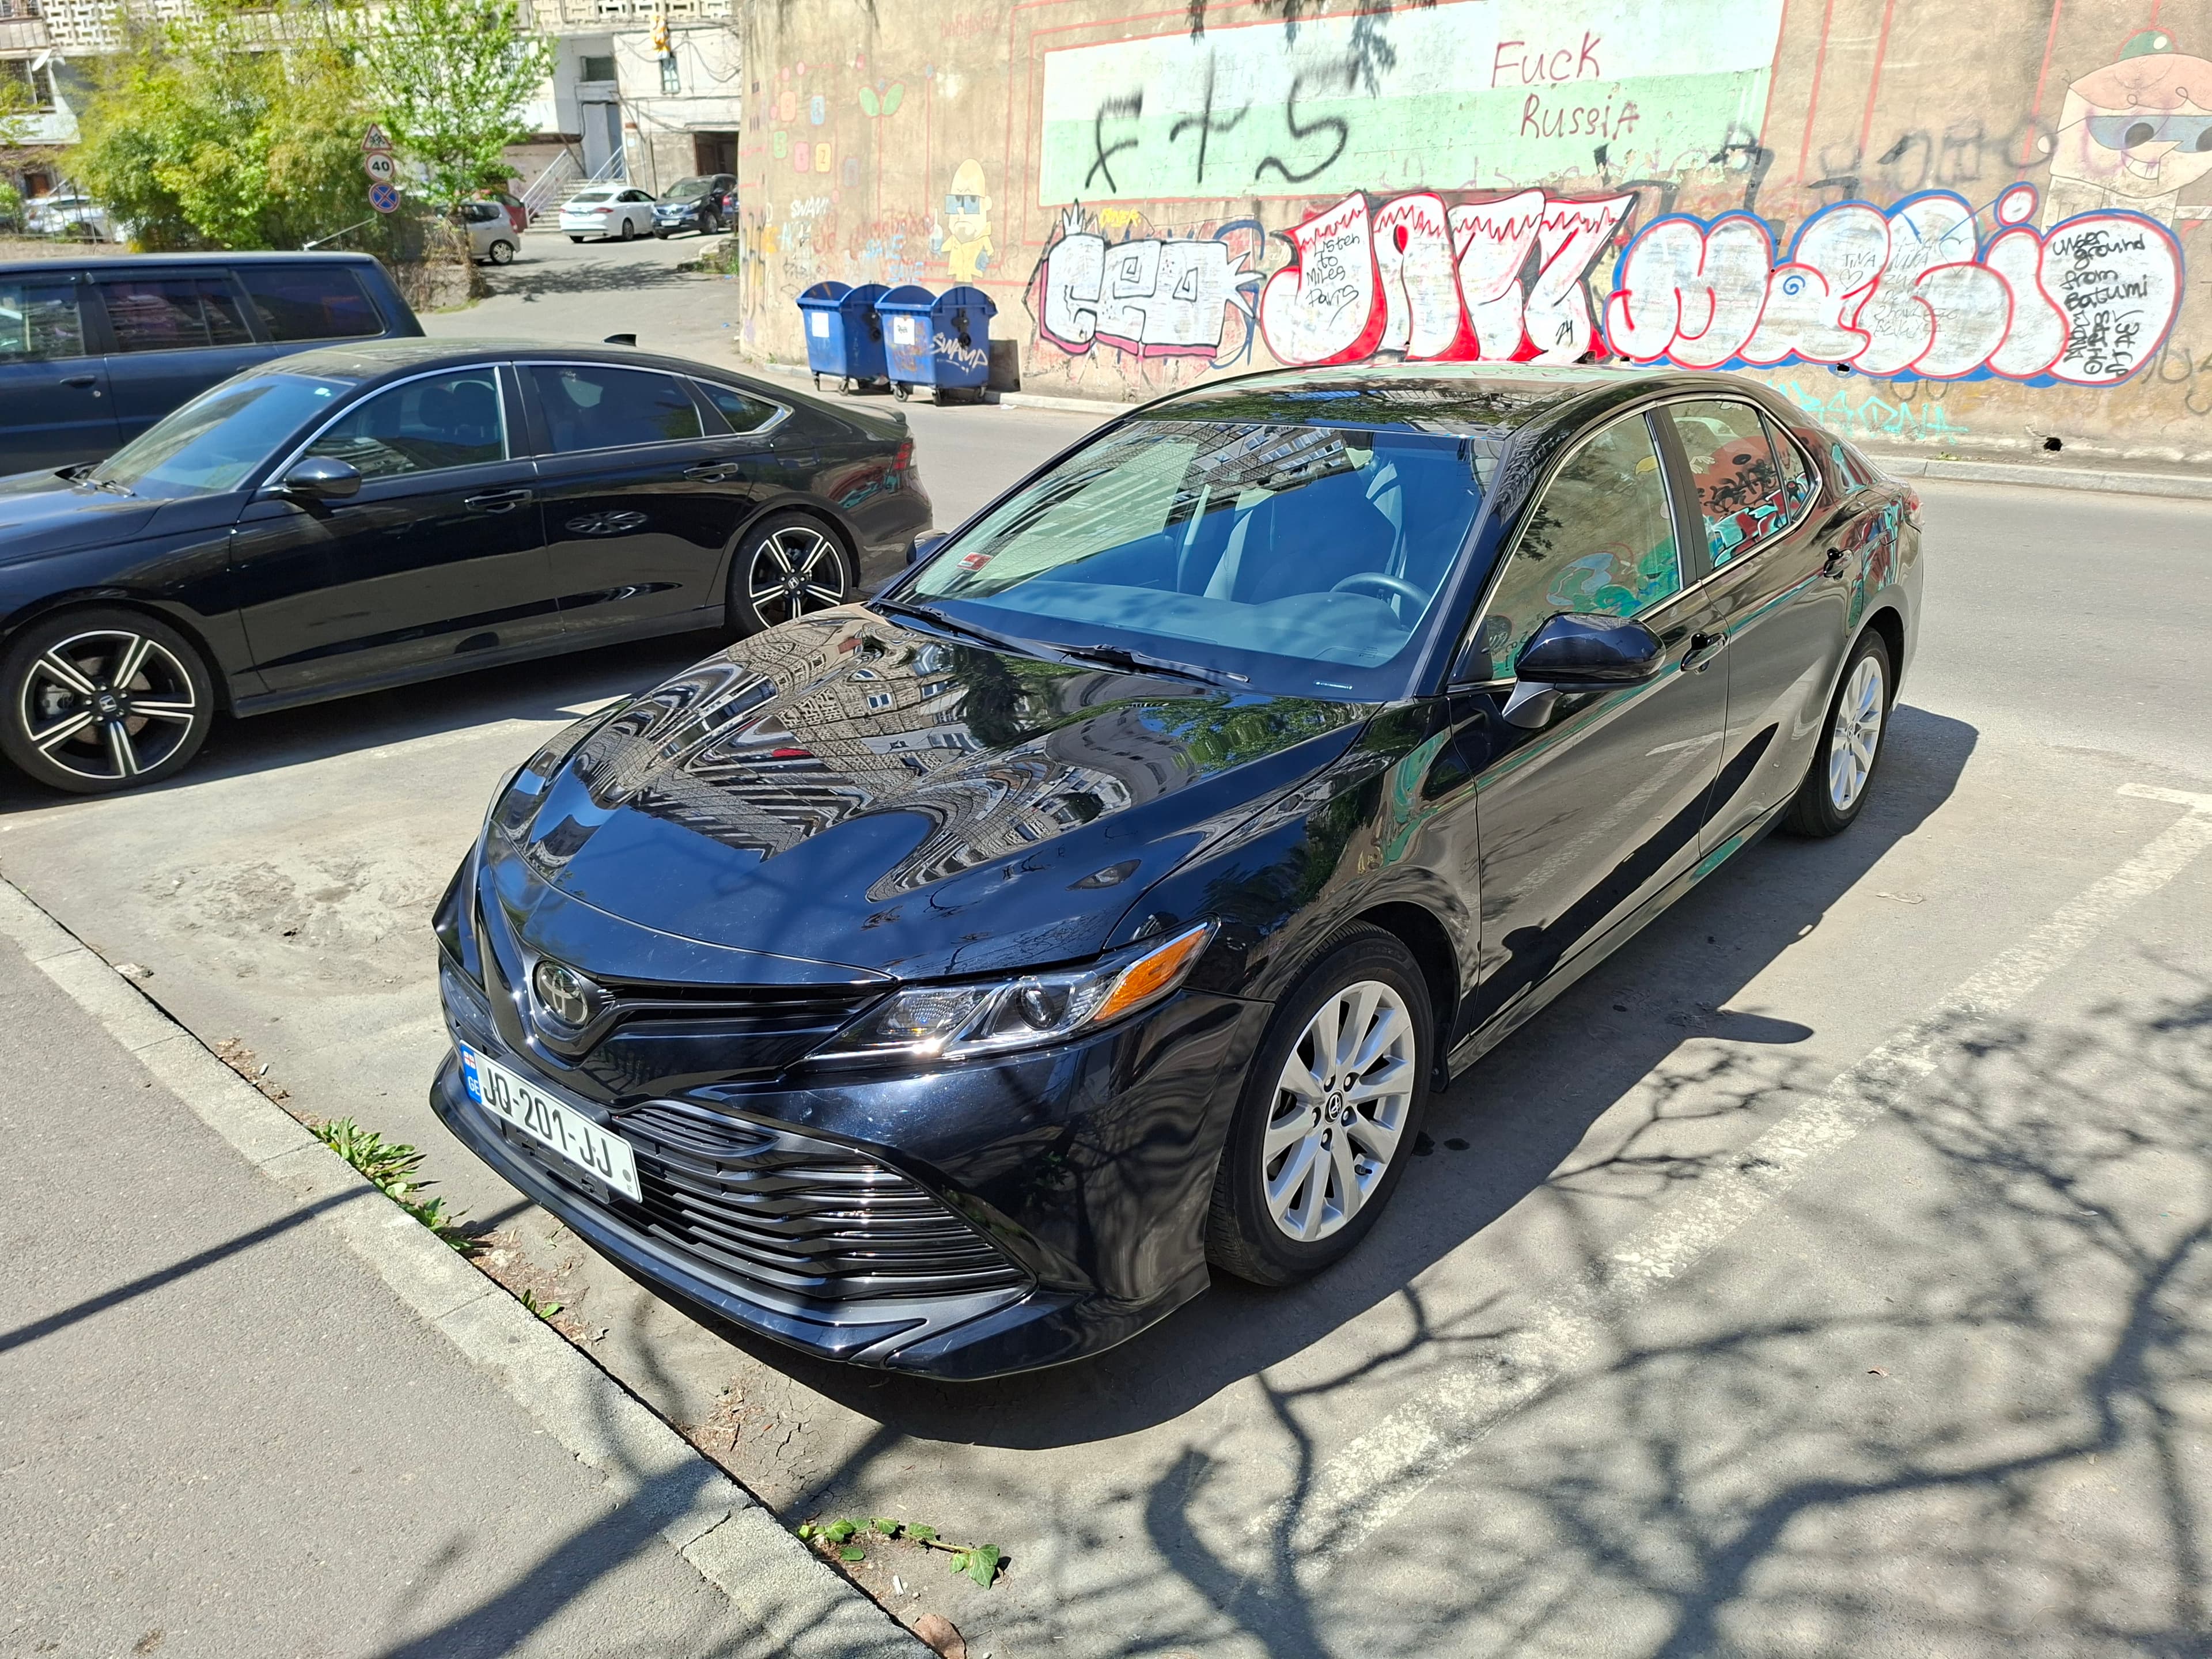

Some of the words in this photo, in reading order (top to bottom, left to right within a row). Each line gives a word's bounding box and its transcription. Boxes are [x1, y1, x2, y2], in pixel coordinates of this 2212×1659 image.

[372, 161, 390, 172] 40
[1317, 252, 1338, 268] to
[2059, 270, 2118, 290] from
[468, 1075, 480, 1096] GE
[483, 1067, 613, 1179] JQ-201-JJ
